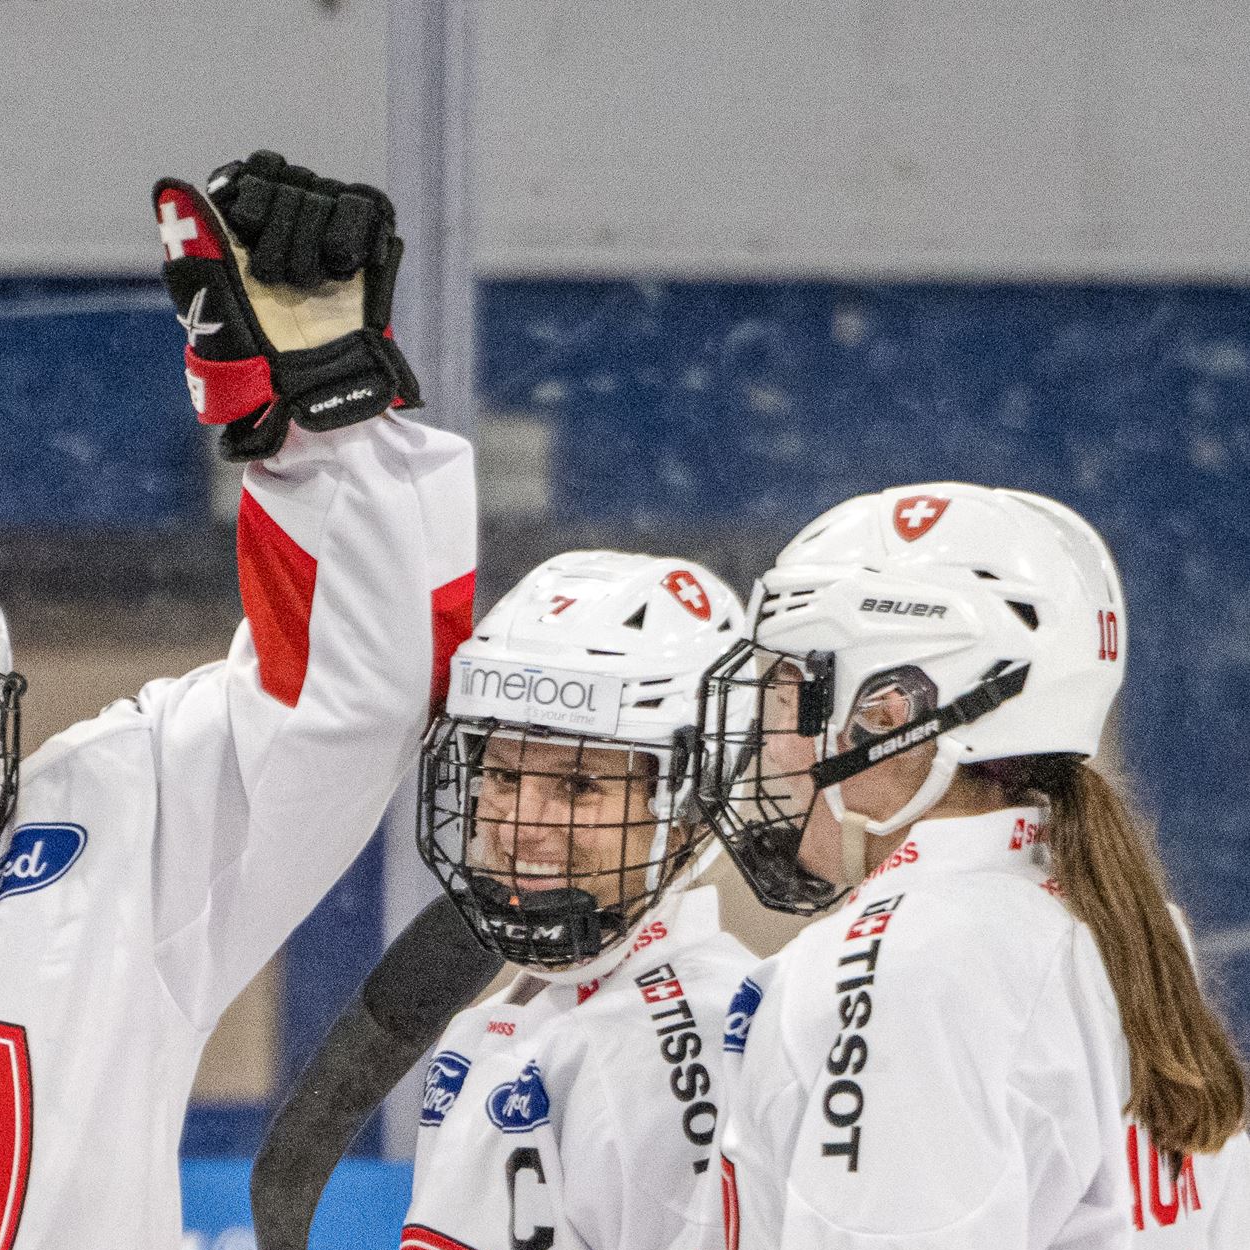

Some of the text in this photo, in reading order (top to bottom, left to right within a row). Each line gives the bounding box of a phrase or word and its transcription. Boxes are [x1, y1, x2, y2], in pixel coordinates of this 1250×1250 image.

[550, 595, 578, 617] 7
[859, 597, 948, 619] BAUER
[1097, 609, 1119, 662] 10
[867, 718, 941, 763] BAUER
[821, 937, 883, 1173] TISSOT
[651, 999, 719, 1175] TISSO
